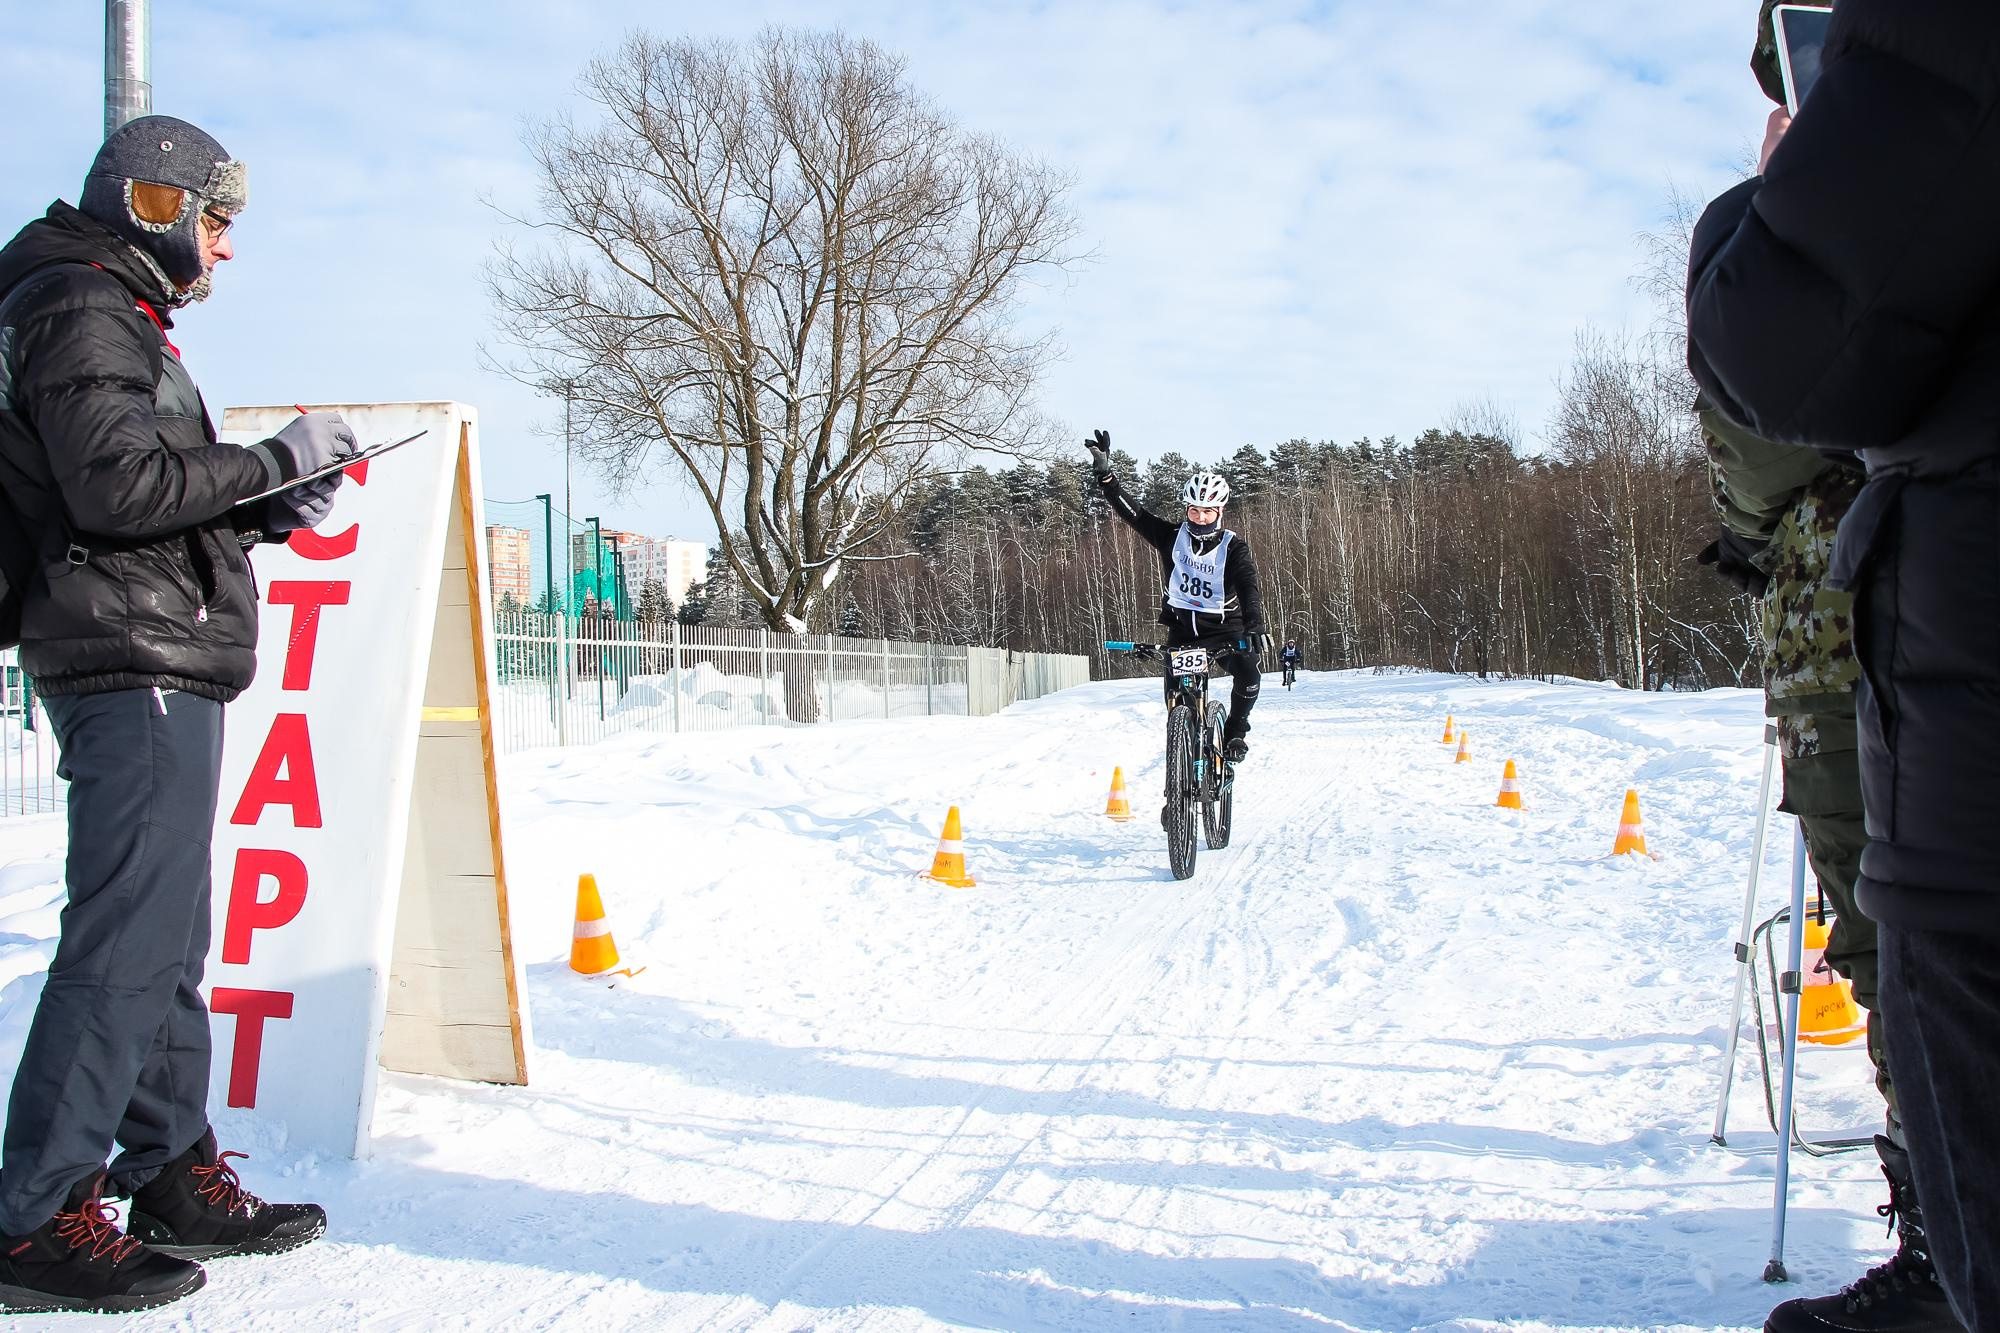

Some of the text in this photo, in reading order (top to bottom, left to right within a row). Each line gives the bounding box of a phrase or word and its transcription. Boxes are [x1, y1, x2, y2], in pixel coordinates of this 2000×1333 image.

[1180, 554, 1215, 574] ЛОБНЯ
[1179, 572, 1213, 599] 385
[1175, 654, 1204, 669] 385
